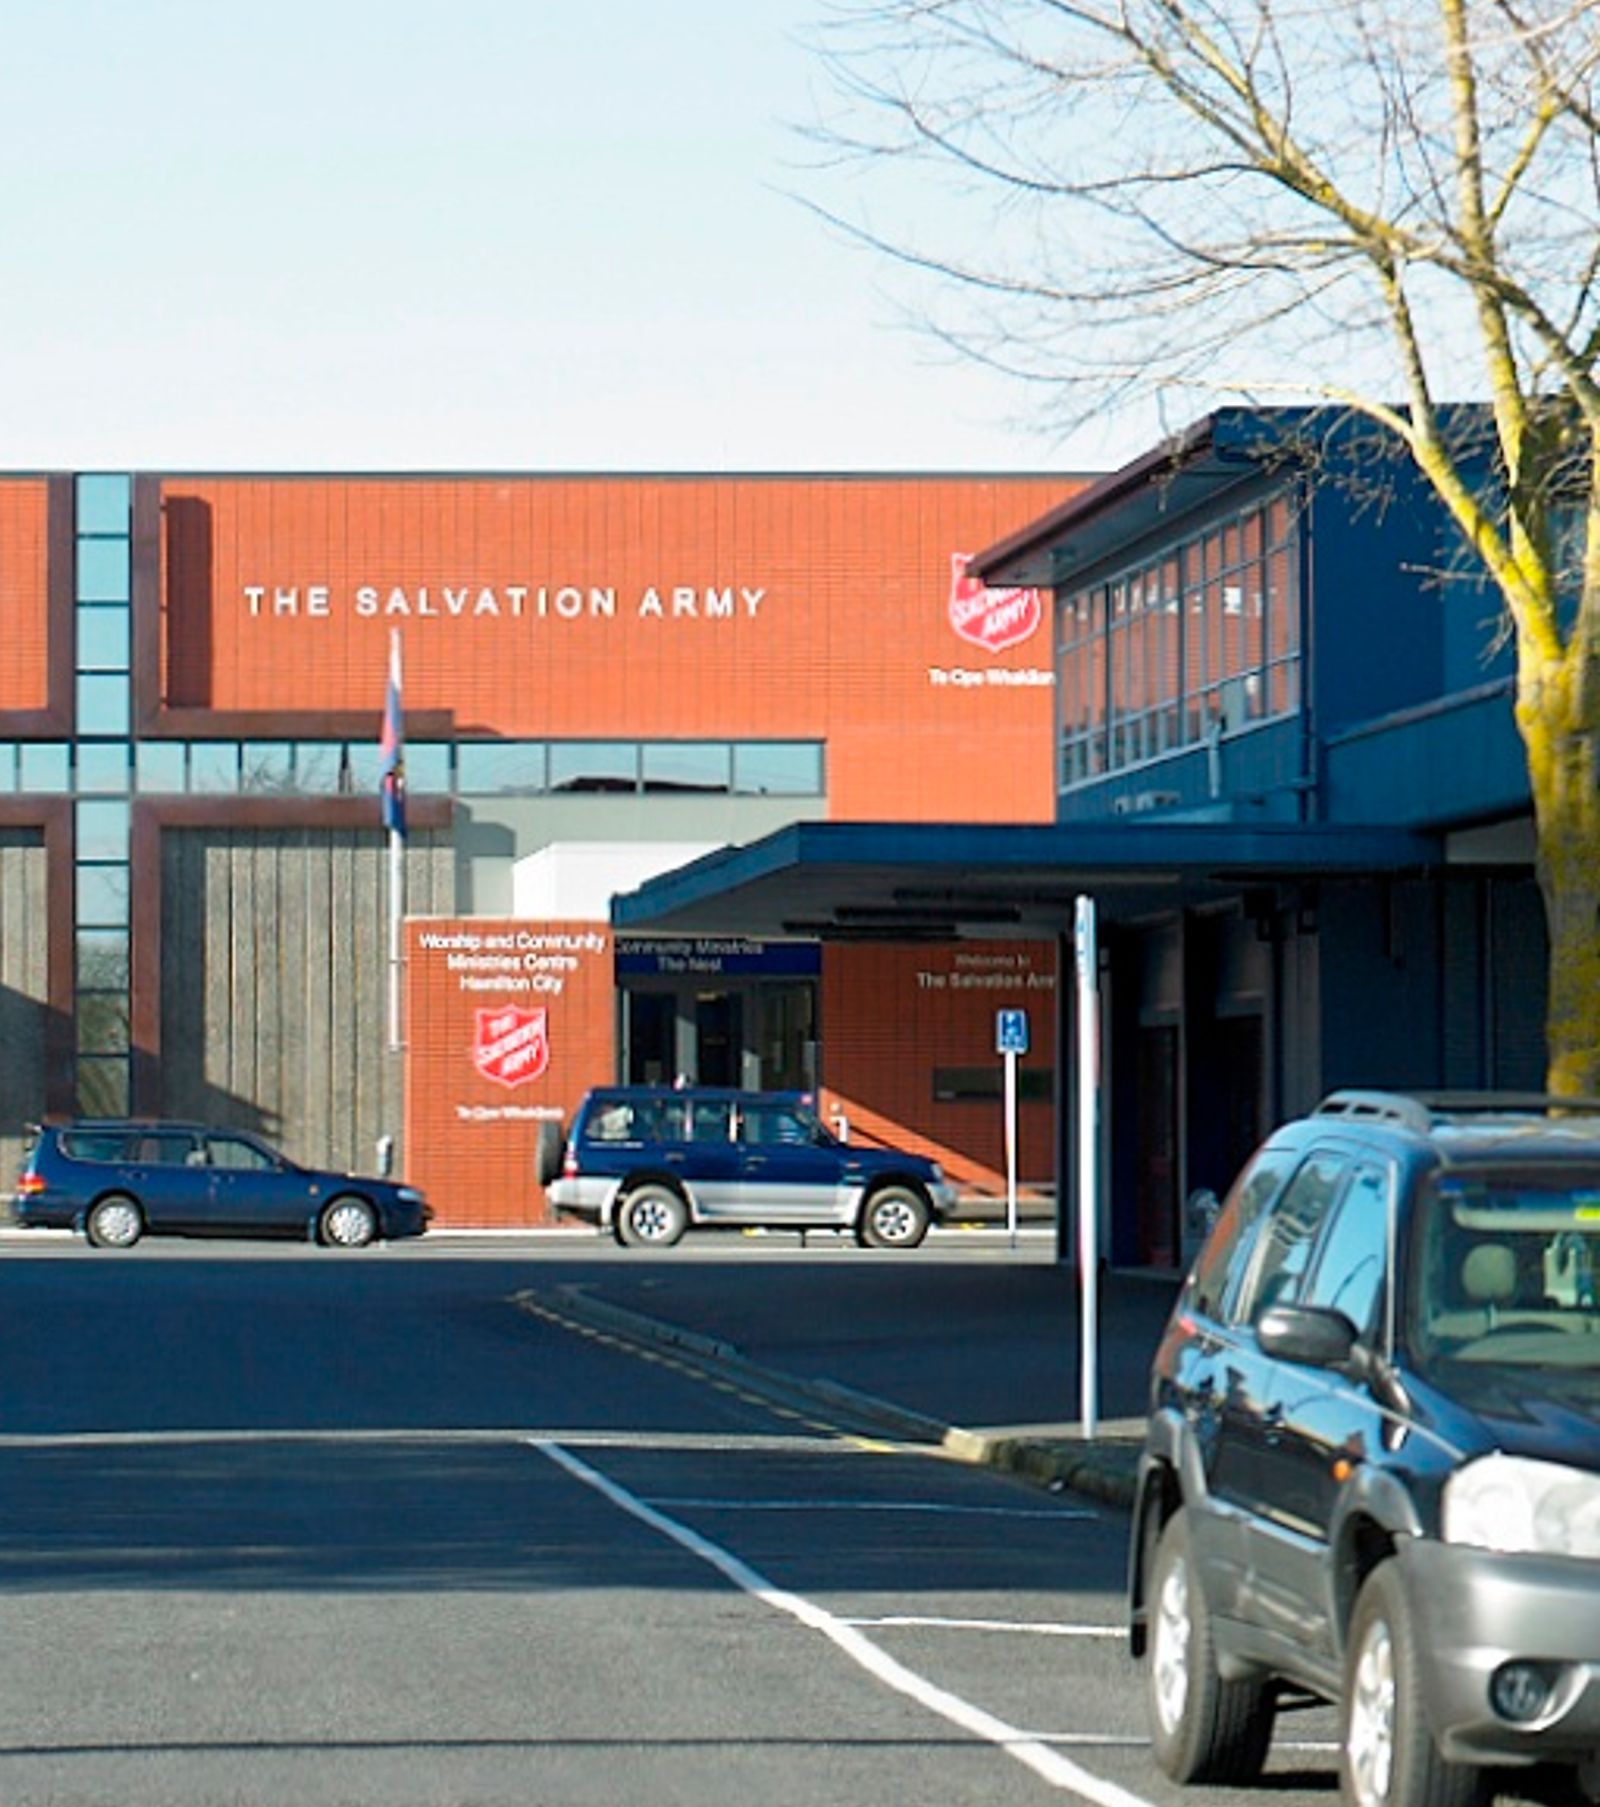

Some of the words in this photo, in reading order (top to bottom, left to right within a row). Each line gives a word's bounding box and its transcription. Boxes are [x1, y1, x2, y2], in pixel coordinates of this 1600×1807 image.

[243, 586, 331, 617] THE
[355, 586, 616, 618] SALVATION
[638, 586, 766, 618] ARMY
[928, 668, 948, 686] Te
[419, 933, 481, 950] Worship
[485, 935, 514, 949] and
[517, 932, 605, 953] Community
[447, 953, 521, 970] Ministries
[523, 953, 579, 970] Centre
[657, 956, 686, 972] The
[460, 975, 530, 990] Hamilton
[532, 975, 564, 995] City
[917, 971, 947, 989] The
[950, 971, 1024, 989] Salvation
[1027, 971, 1056, 989] Arm
